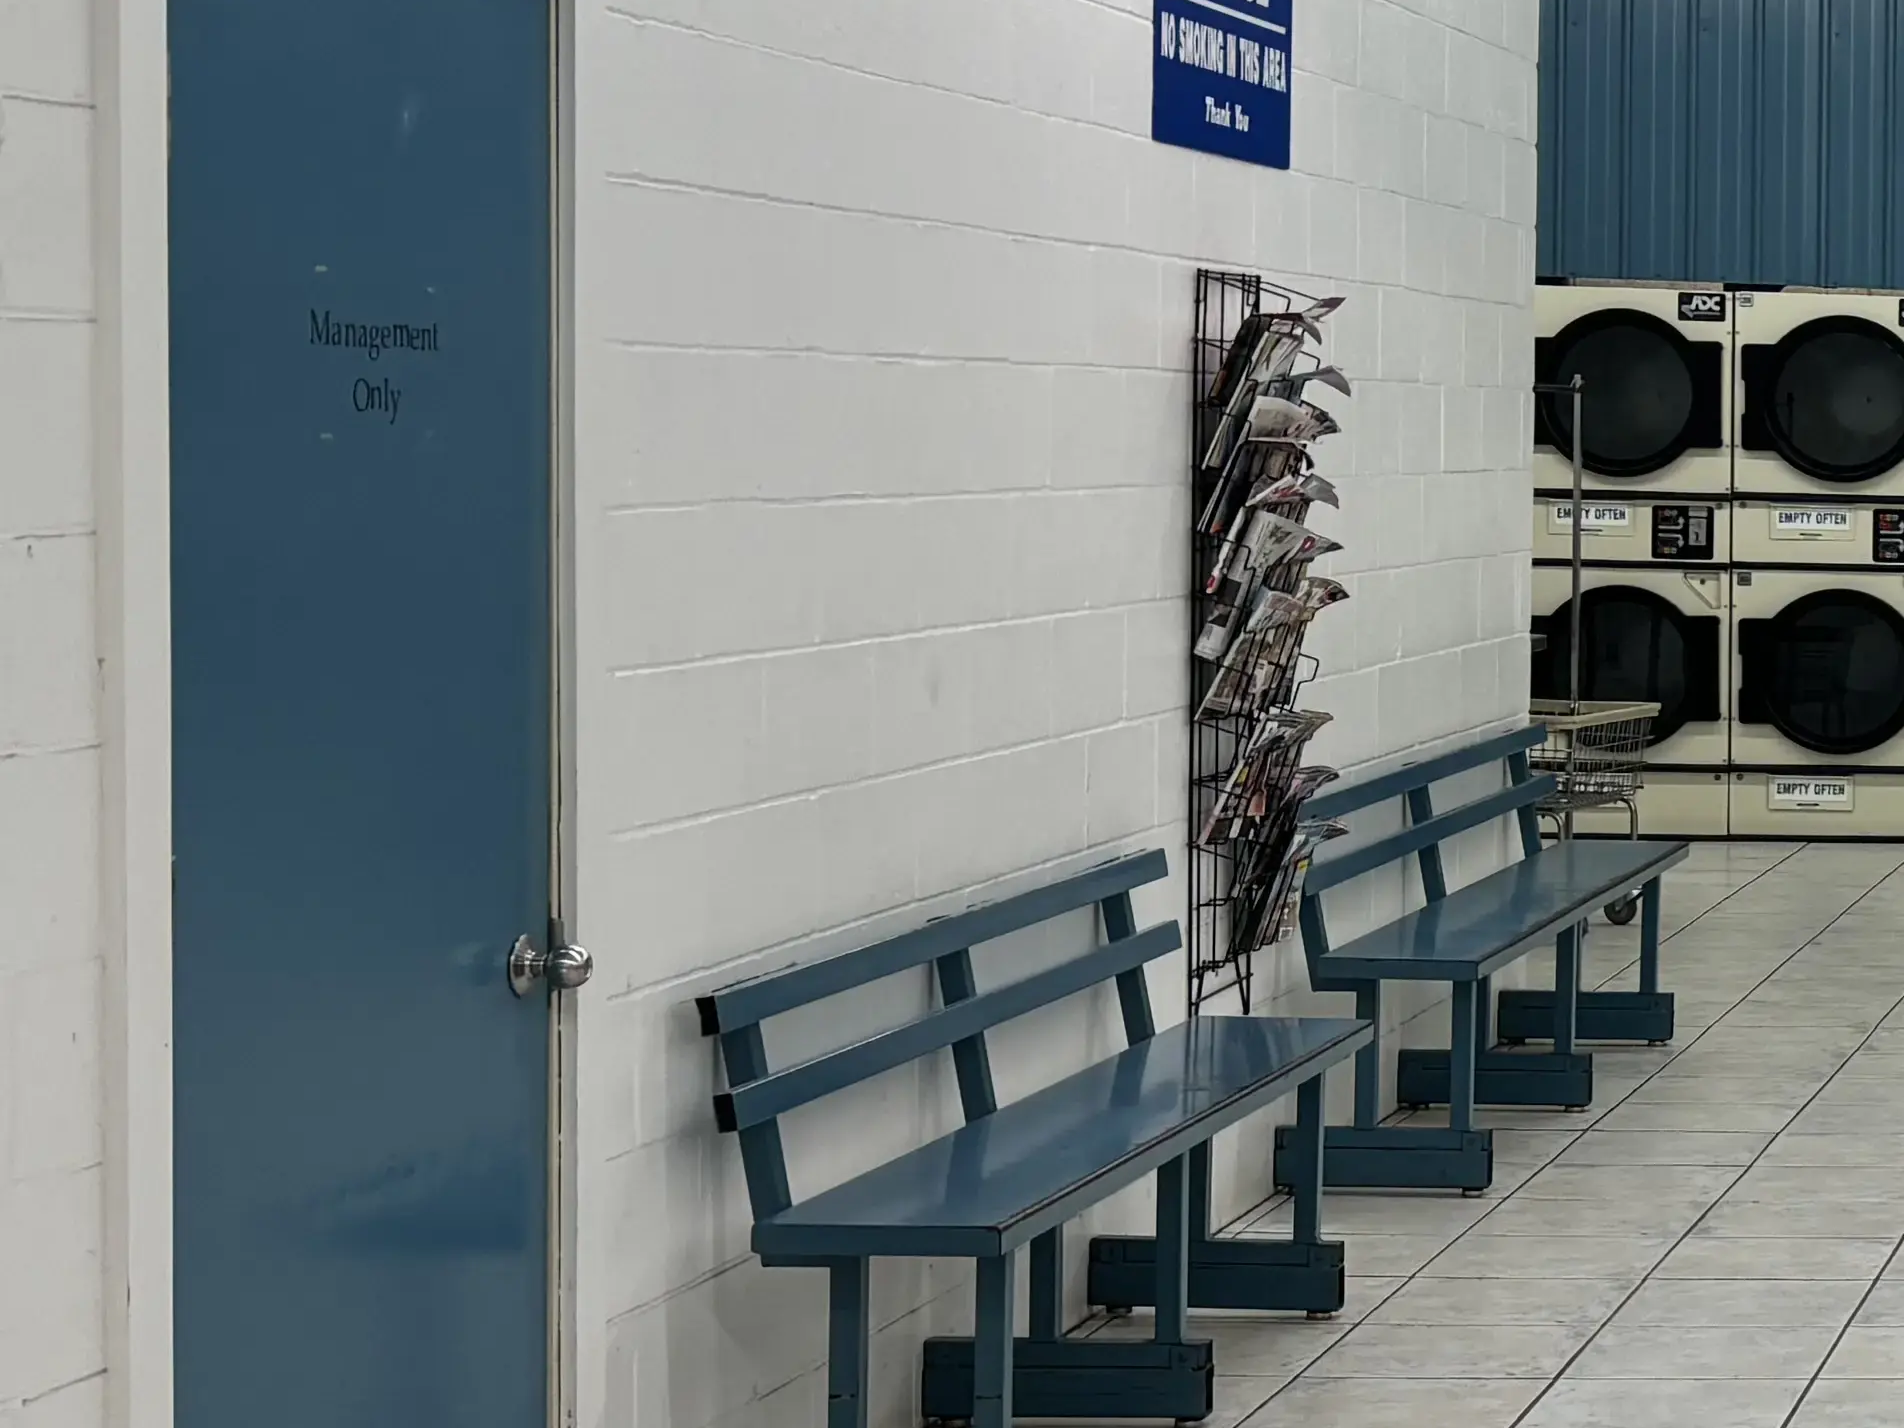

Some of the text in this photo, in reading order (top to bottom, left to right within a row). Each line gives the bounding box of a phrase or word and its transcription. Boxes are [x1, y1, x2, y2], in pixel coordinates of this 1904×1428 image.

[1161, 11, 1286, 93] NO SMOKING IN THIS AREA
[1205, 96, 1249, 132] Thank You
[1690, 295, 1720, 311] ADC
[310, 308, 439, 361] Management
[353, 378, 401, 425] Only
[1557, 507, 1626, 520] EMTY OFTEN
[1779, 512, 1846, 524] EMPTY OFTEN
[1777, 783, 1845, 795] EMPTY OFTEN
